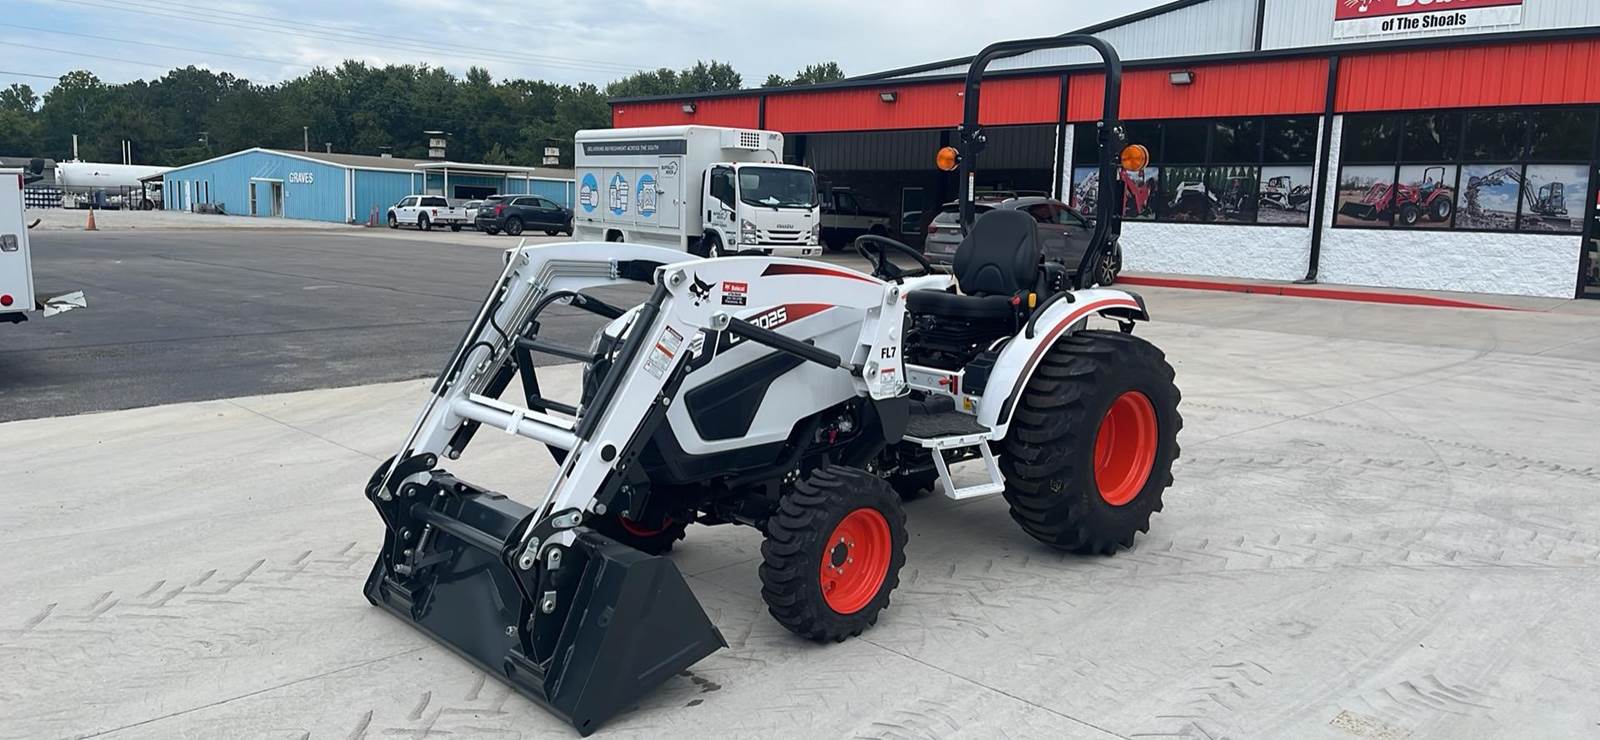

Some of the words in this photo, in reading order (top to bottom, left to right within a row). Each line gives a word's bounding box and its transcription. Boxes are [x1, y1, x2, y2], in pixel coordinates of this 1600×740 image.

[1382, 18, 1395, 31] of
[1397, 17, 1419, 30] The
[1422, 12, 1467, 28] Shoals
[289, 172, 314, 184] GRAVES
[881, 346, 896, 359] FL7
